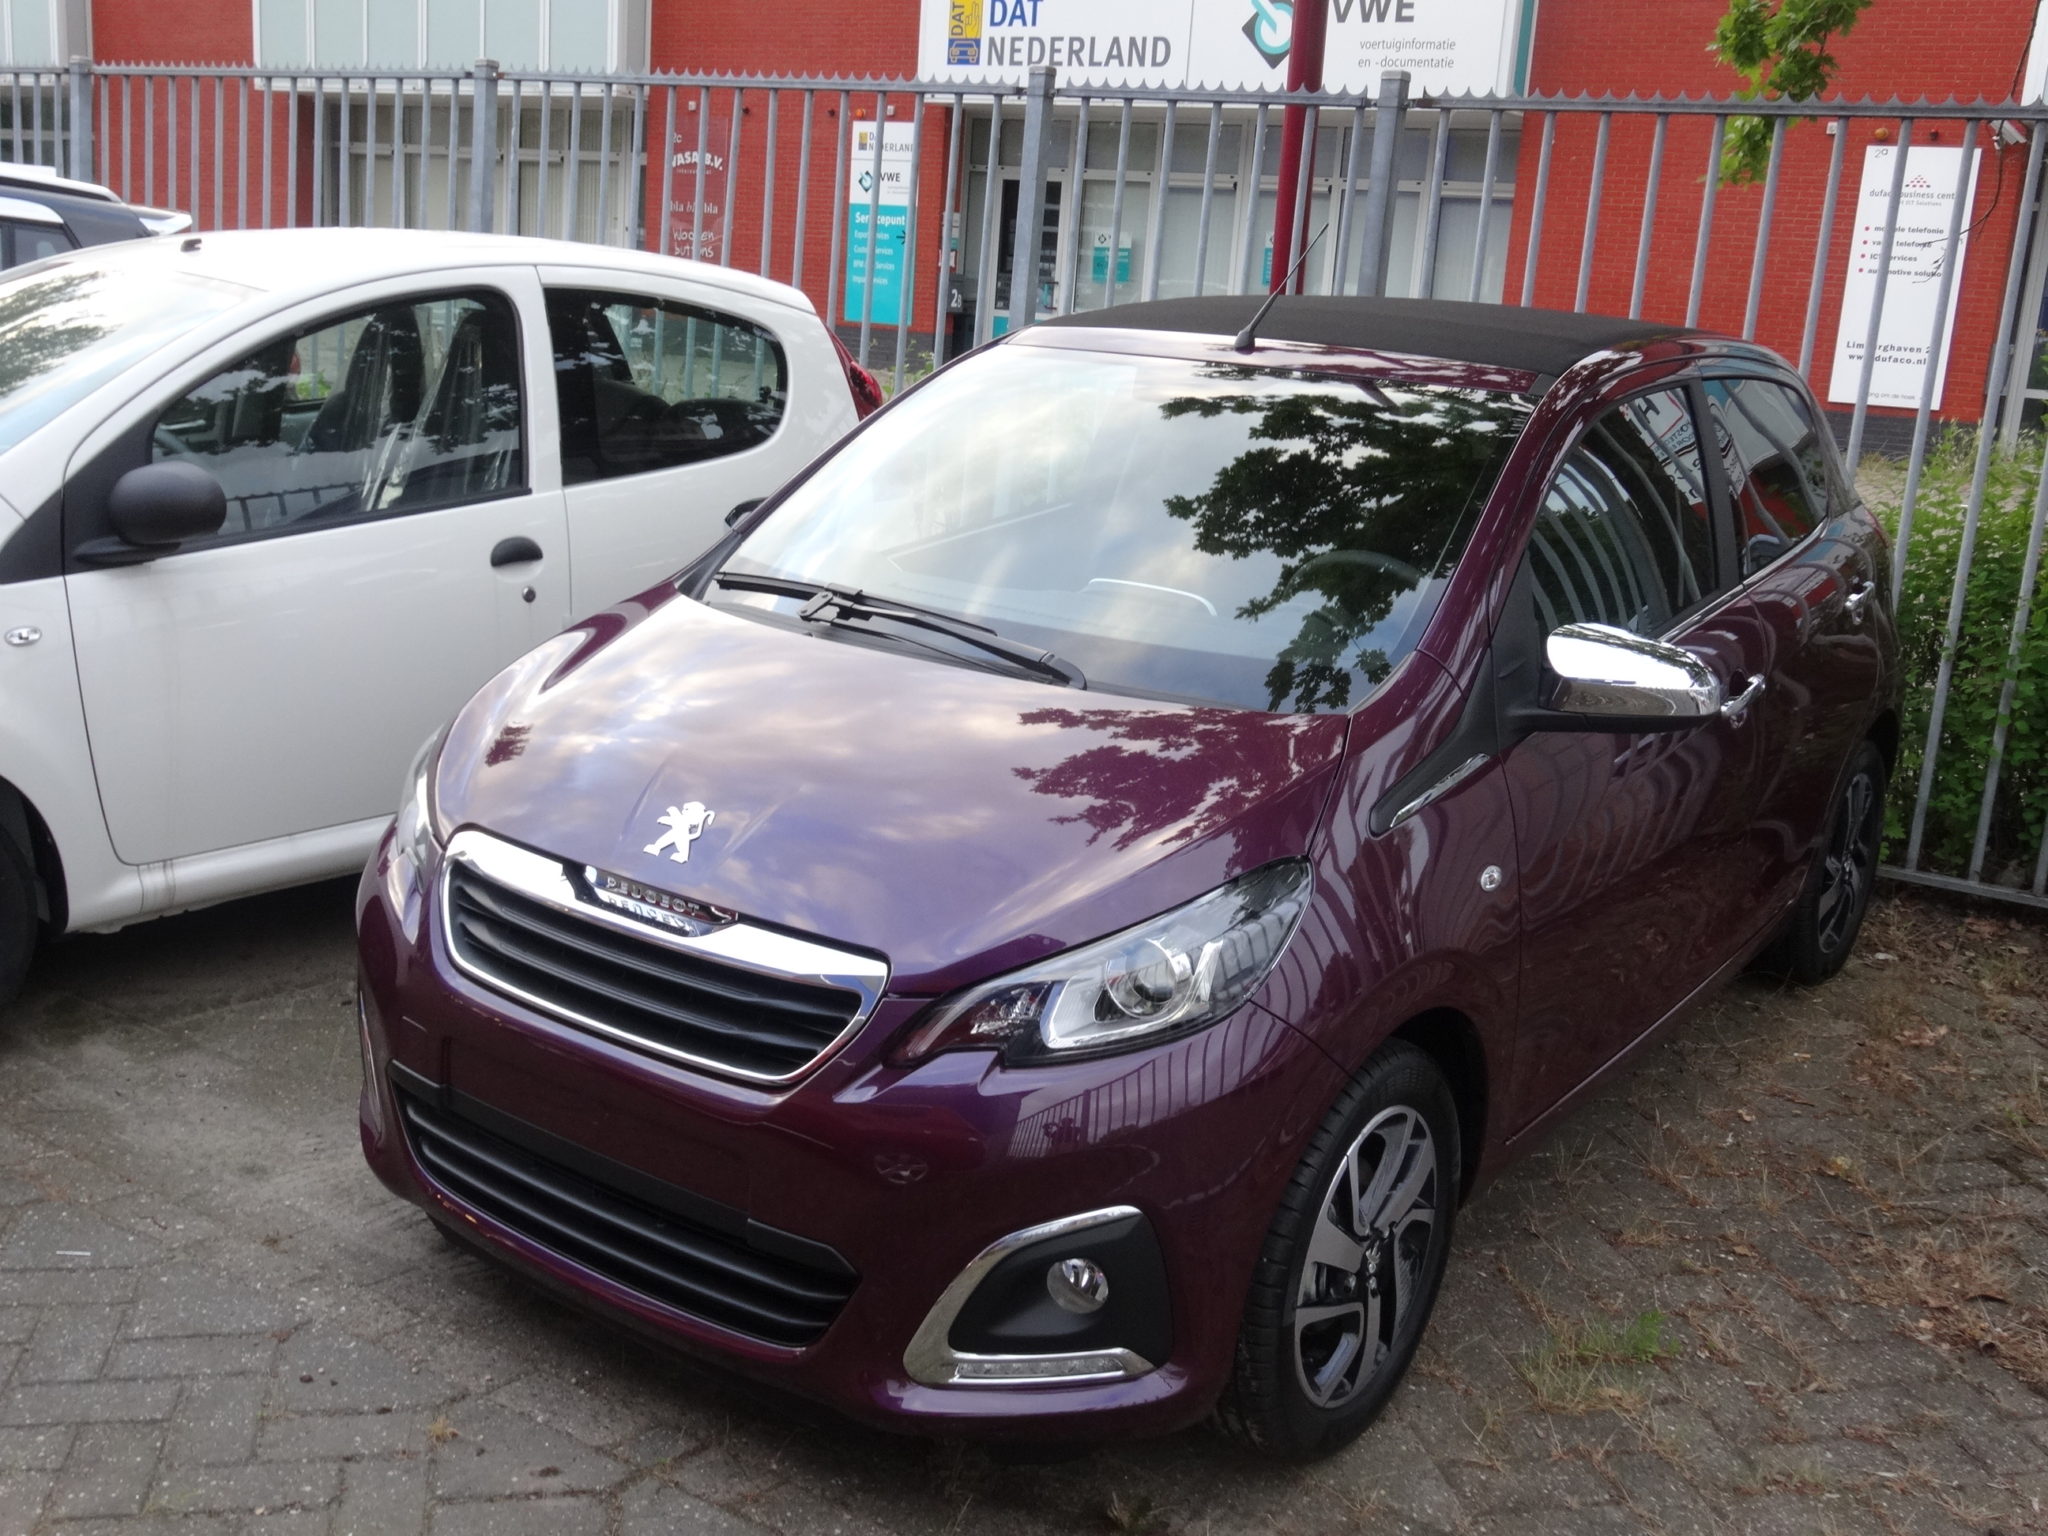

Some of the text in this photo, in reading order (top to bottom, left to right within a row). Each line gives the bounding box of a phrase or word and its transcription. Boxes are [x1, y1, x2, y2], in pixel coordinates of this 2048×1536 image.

[951, 2, 964, 36] DAT
[989, 0, 1043, 27] DAT
[1333, 0, 1414, 23] VWE
[987, 36, 1172, 67] NEDERLAND
[1360, 37, 1456, 52] voertuiginformatie
[1358, 58, 1371, 68] en
[704, 153, 723, 171] B.V.
[880, 172, 900, 182] VWE
[1869, 189, 1891, 197] dufac
[855, 211, 905, 227] Sercepunt
[1846, 341, 1922, 353] Limrghaven
[1848, 354, 1926, 366] wwdufaco.nl
[606, 876, 700, 917] PEUGEOT
